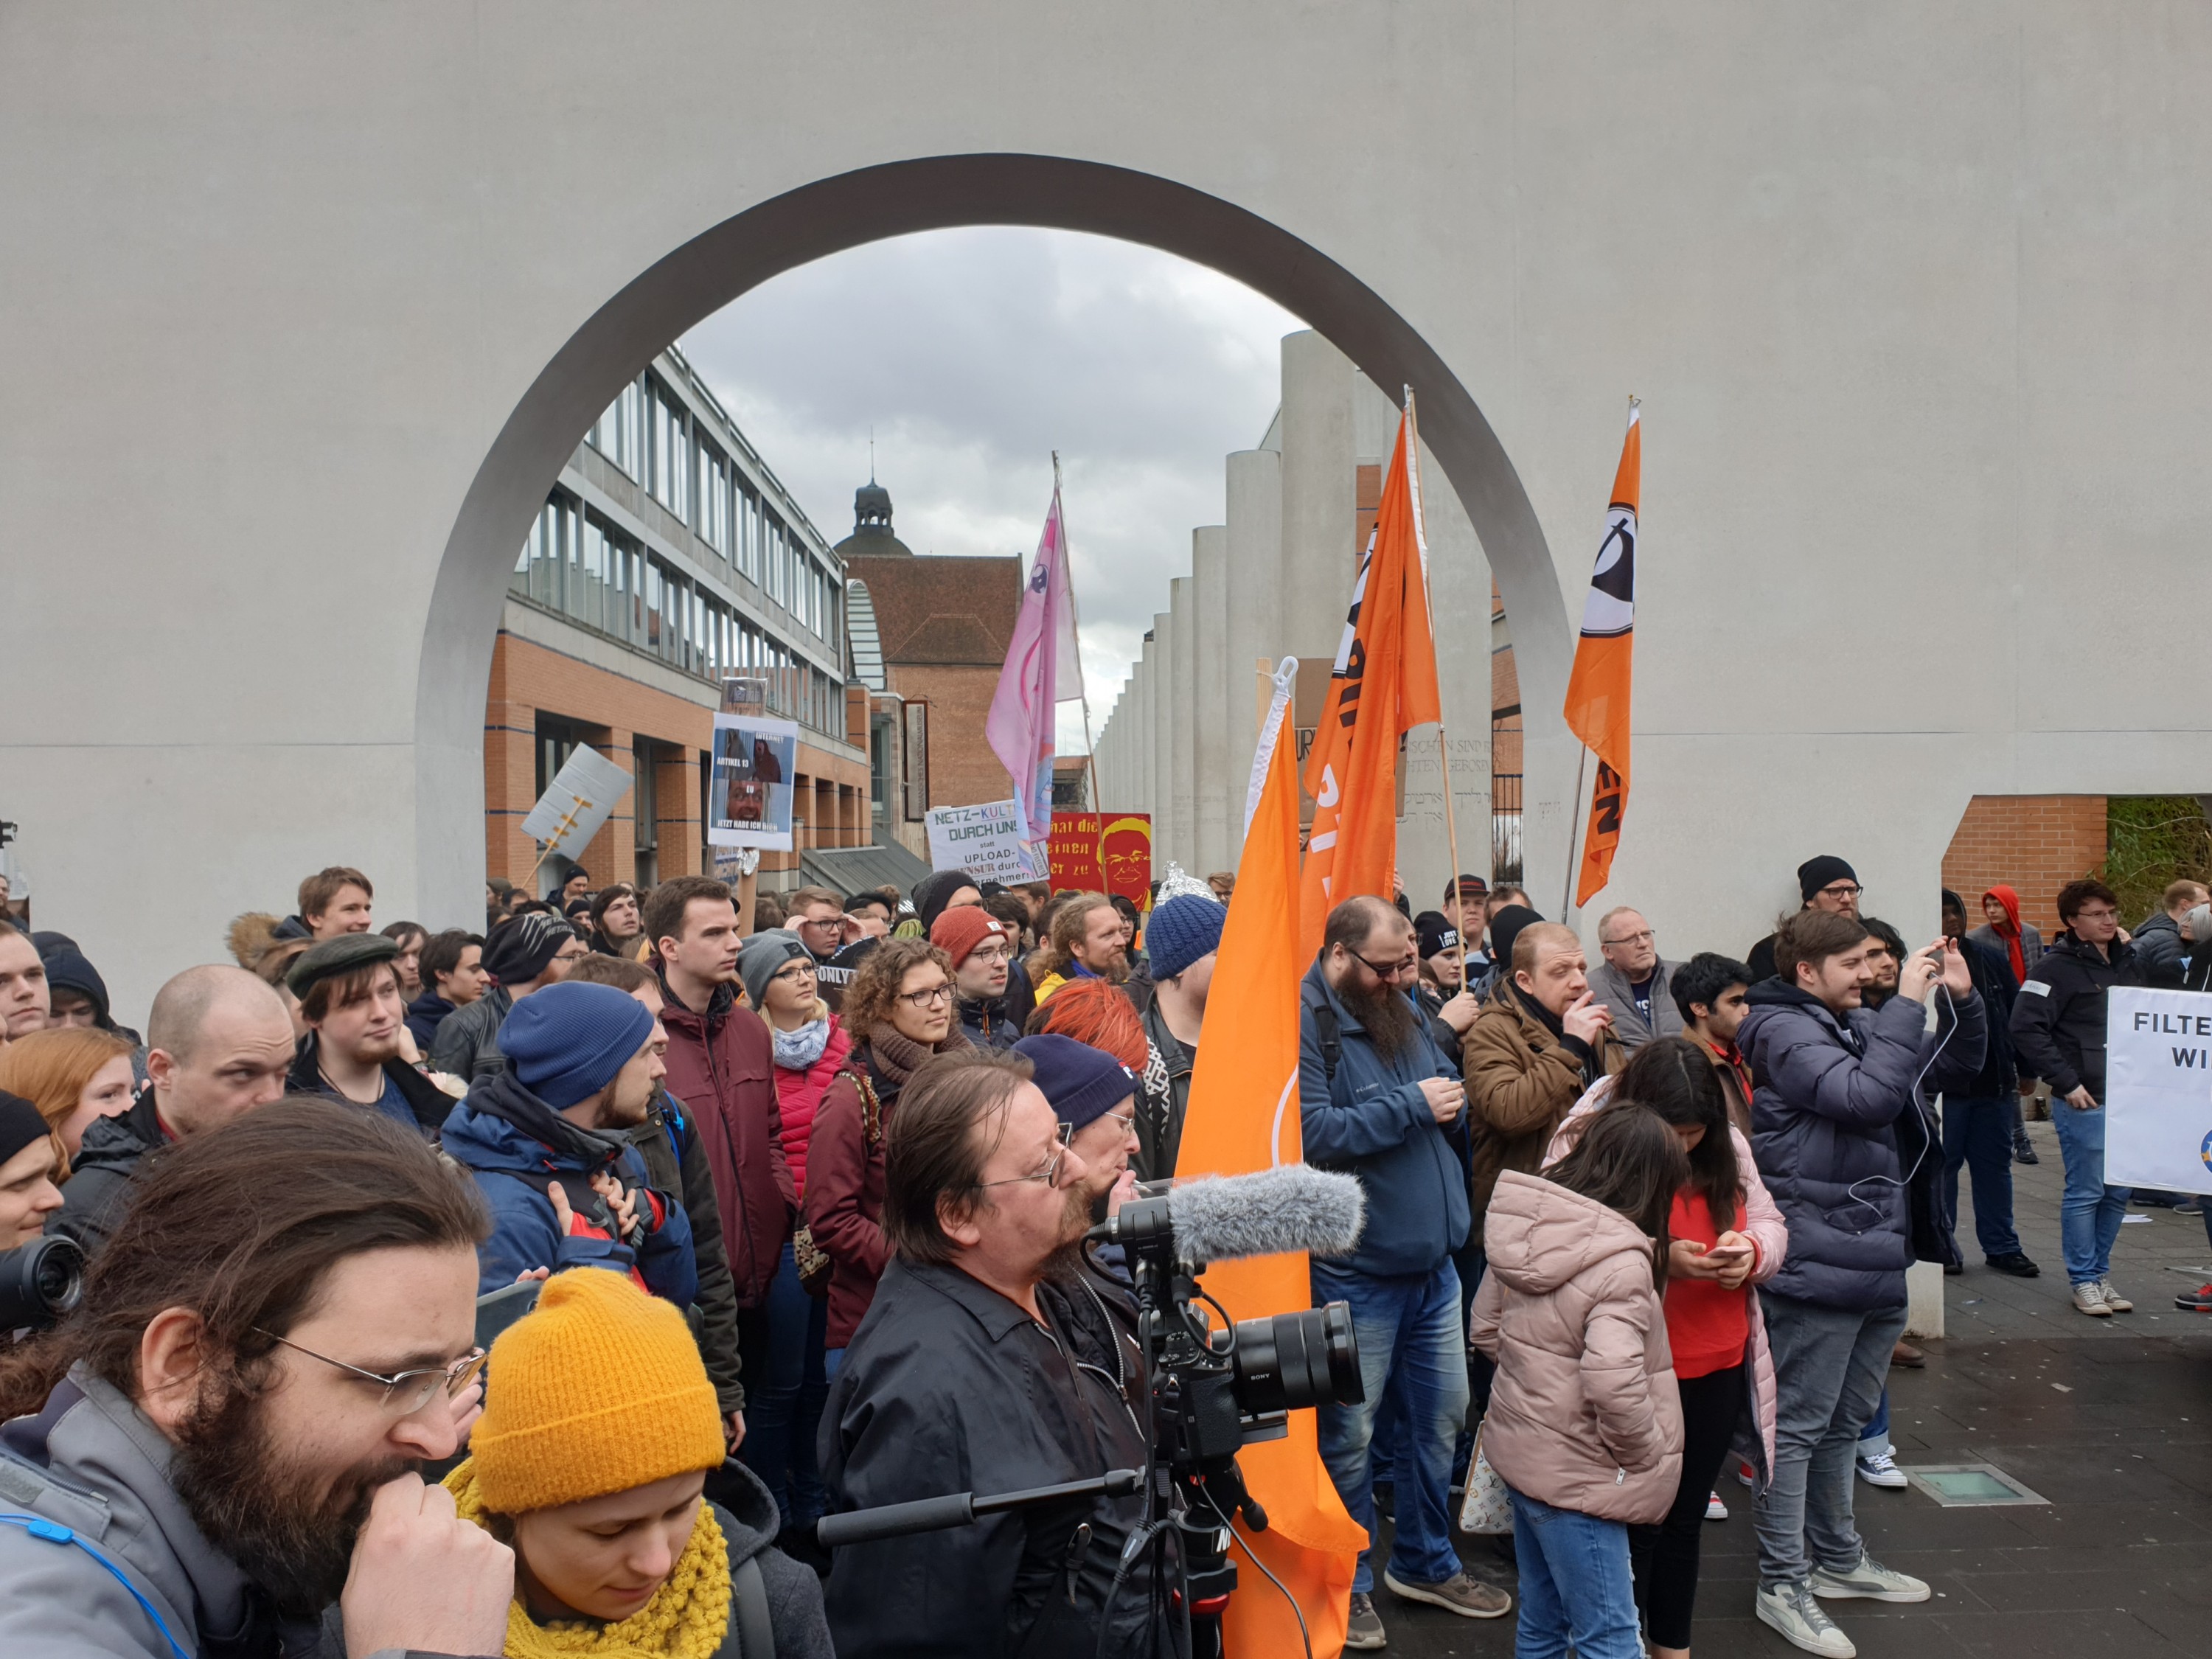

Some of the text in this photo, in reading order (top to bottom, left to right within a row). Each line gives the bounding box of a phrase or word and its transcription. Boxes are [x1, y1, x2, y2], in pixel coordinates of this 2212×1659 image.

[756, 731, 785, 744] INTERNET
[717, 757, 748, 768] ARTIKEL 13
[746, 785, 754, 793] EU
[935, 804, 1015, 825] NETZ-KULT
[717, 818, 733, 829] JETZT
[734, 820, 749, 830] HABE
[750, 821, 761, 830] ICH
[1078, 818, 1098, 833] die
[949, 824, 993, 841] DURCH
[964, 849, 1015, 863] UPLOAD-
[1444, 930, 1457, 939] JUST
[818, 967, 849, 984] ONLY
[2171, 1047, 2212, 1070] WI
[1251, 1373, 1270, 1381] SONY
